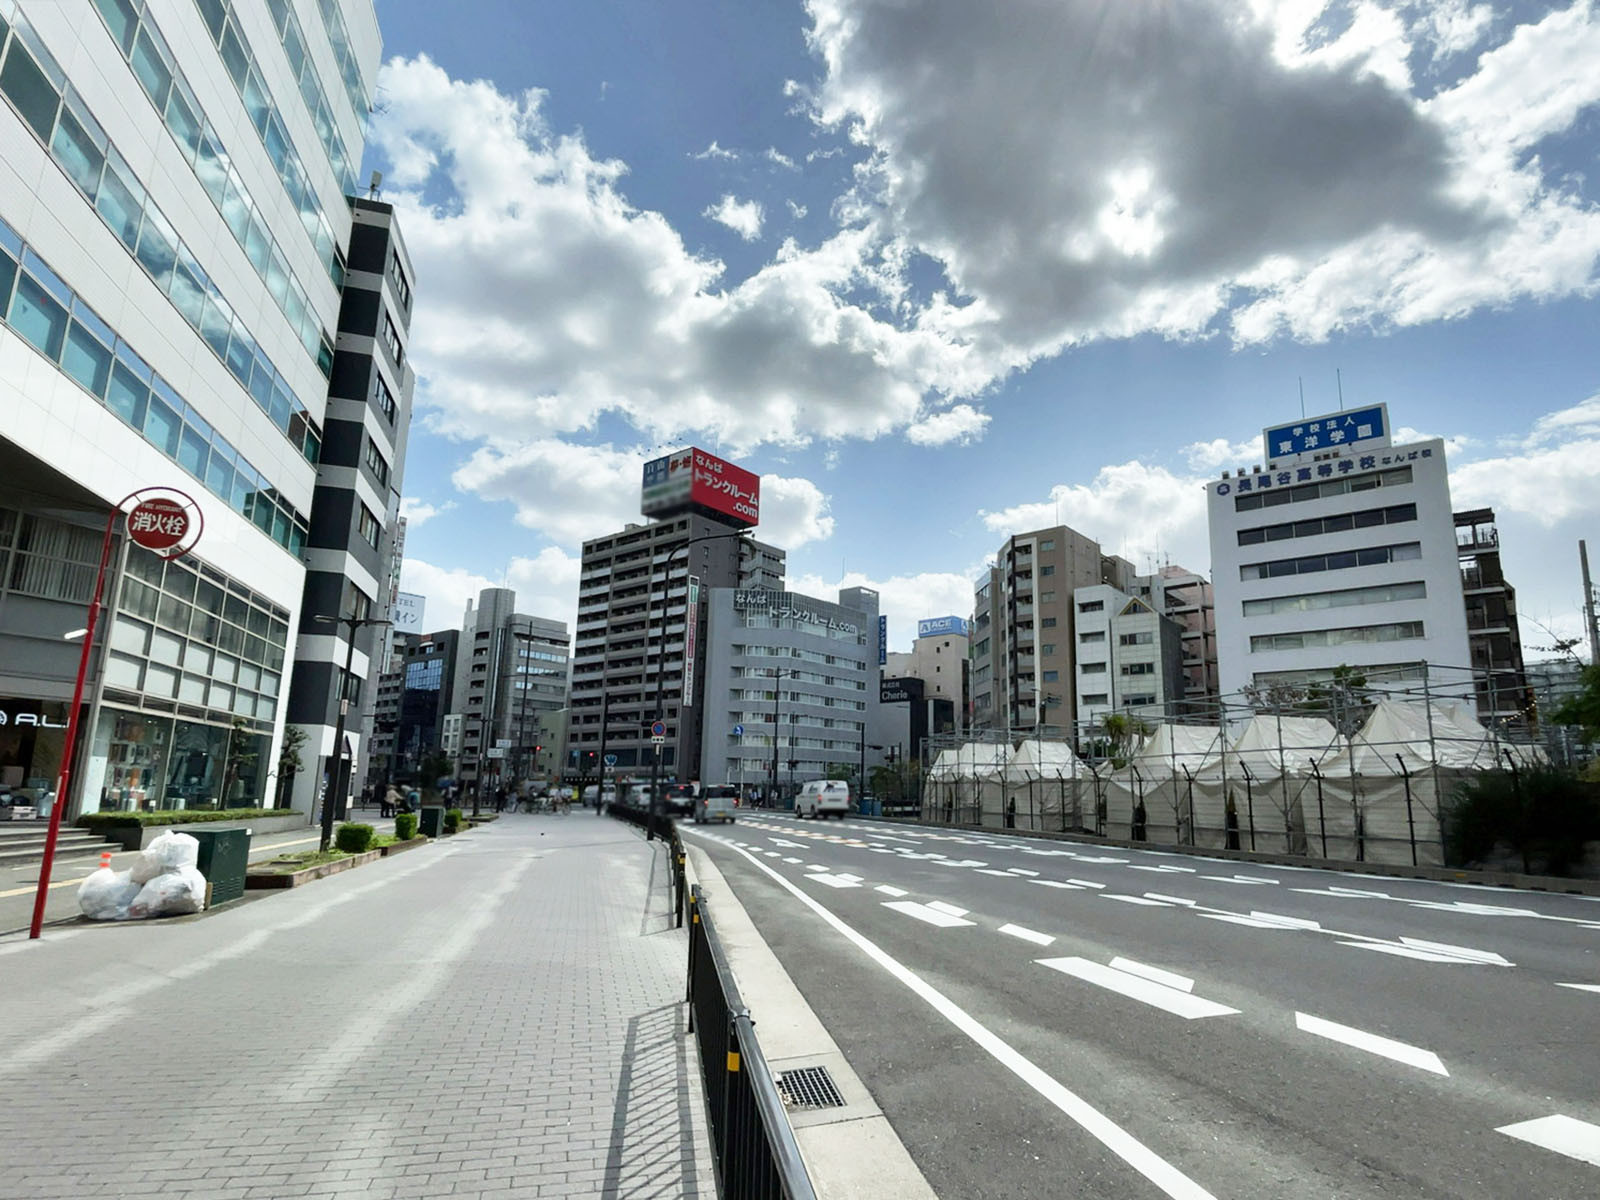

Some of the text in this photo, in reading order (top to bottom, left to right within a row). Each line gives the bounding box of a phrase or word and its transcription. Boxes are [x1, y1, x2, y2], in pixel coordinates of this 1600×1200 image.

[1279, 423, 1373, 453] 東洋学園
[1292, 416, 1355, 437] 学校法人
[694, 469, 758, 506] トランクルーム
[1237, 455, 1376, 493] 長尾谷高等学校
[733, 501, 757, 518] .com
[132, 511, 185, 536] 消火栓
